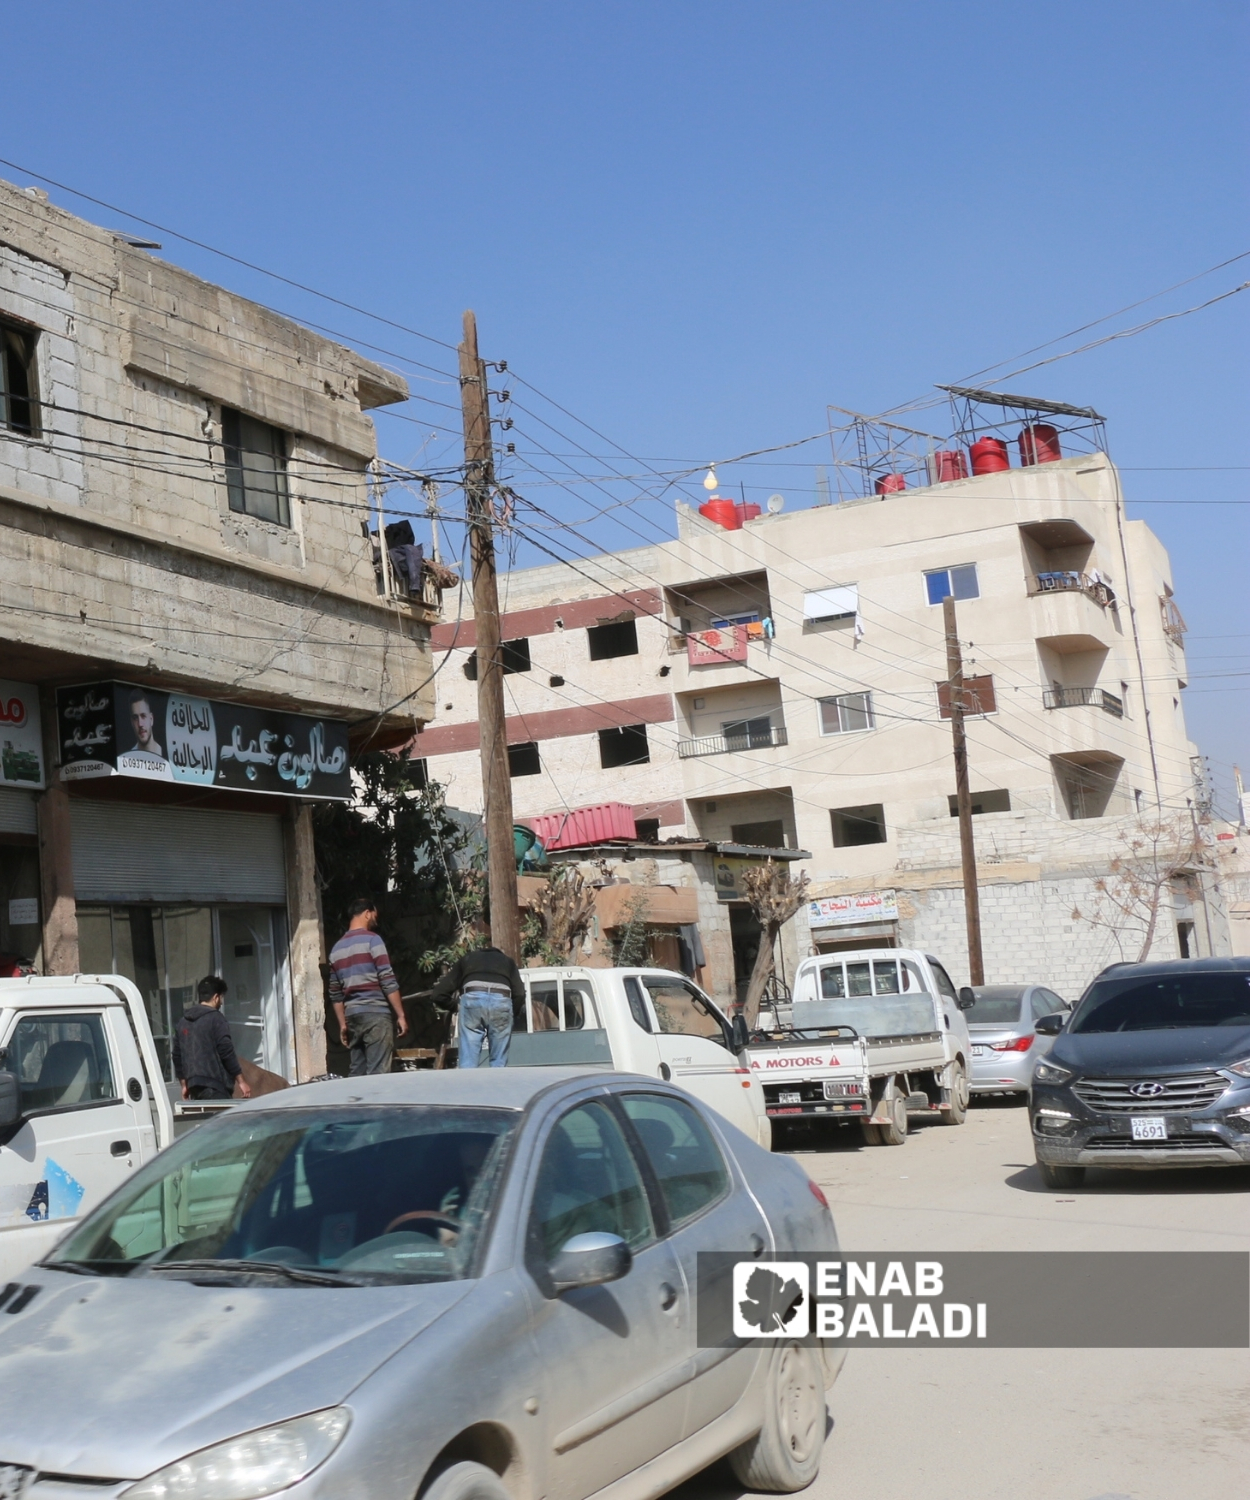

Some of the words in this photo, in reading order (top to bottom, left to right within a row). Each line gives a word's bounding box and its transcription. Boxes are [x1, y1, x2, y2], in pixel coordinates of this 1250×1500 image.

[64, 690, 109, 720] صالون
[171, 700, 211, 735] للحلاقة
[64, 723, 112, 755] عبد
[173, 740, 213, 775] الرجالية
[220, 725, 278, 781] عبد
[277, 722, 347, 789] صالون
[70, 763, 104, 774] 0937120467
[129, 757, 167, 773] 0937120467
[821, 899, 852, 915] النجاح
[855, 894, 882, 910] مكتبة
[766, 1056, 823, 1069] MOTORS
[1135, 1126, 1165, 1138] 4691
